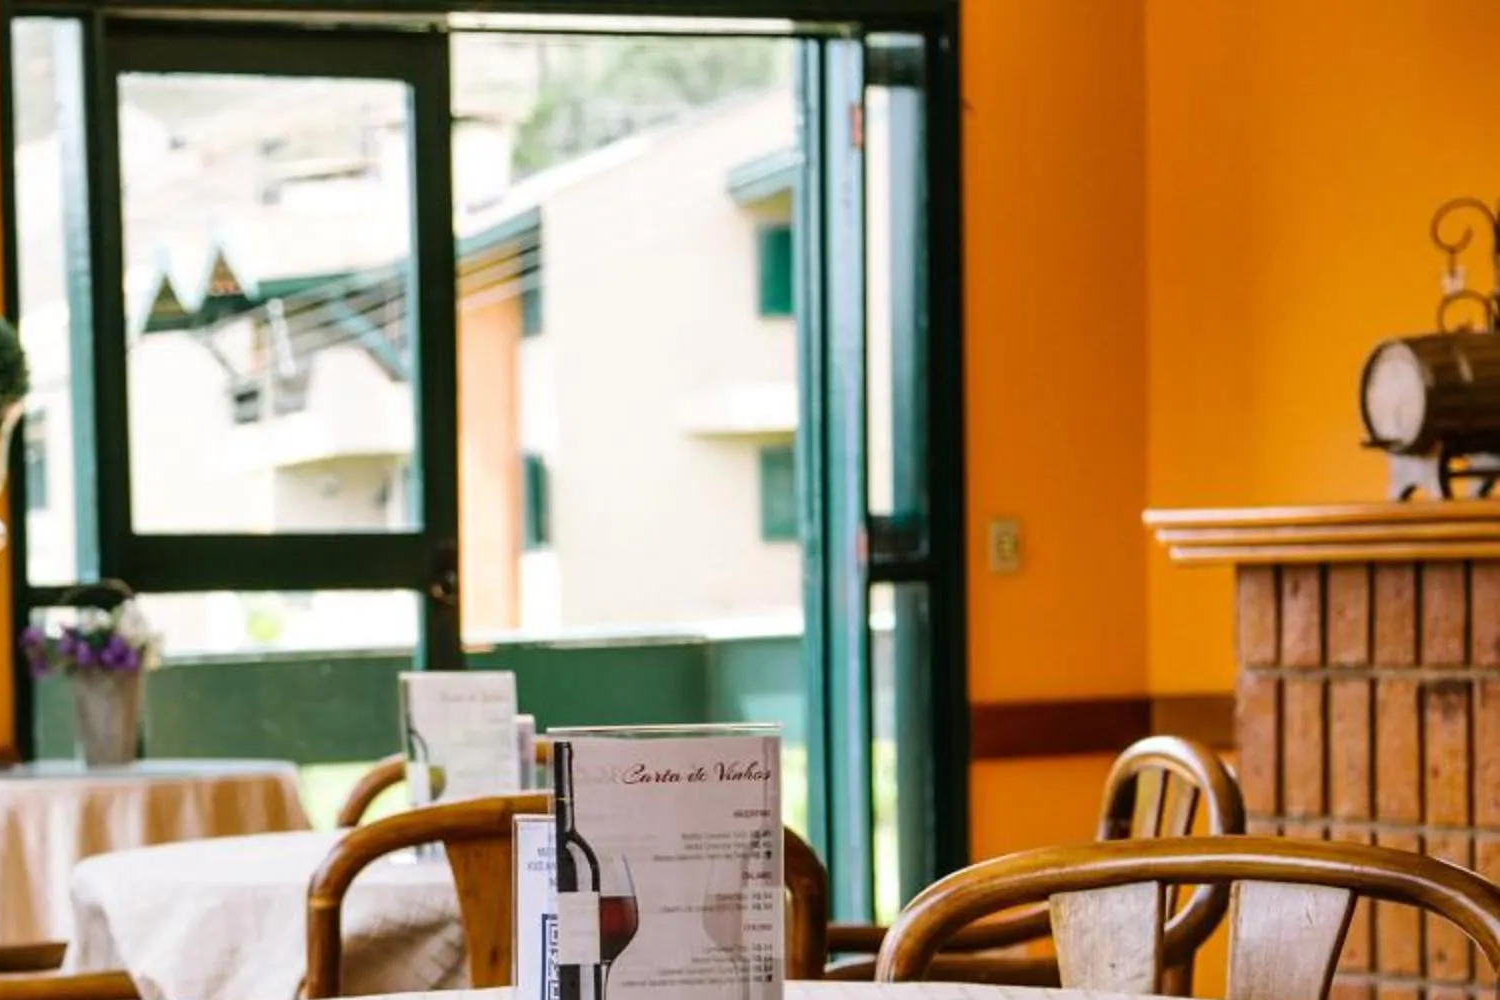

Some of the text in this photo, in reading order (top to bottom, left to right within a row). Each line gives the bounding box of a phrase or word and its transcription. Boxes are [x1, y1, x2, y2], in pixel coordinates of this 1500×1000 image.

[622, 761, 772, 785] Carta de Vinhos
